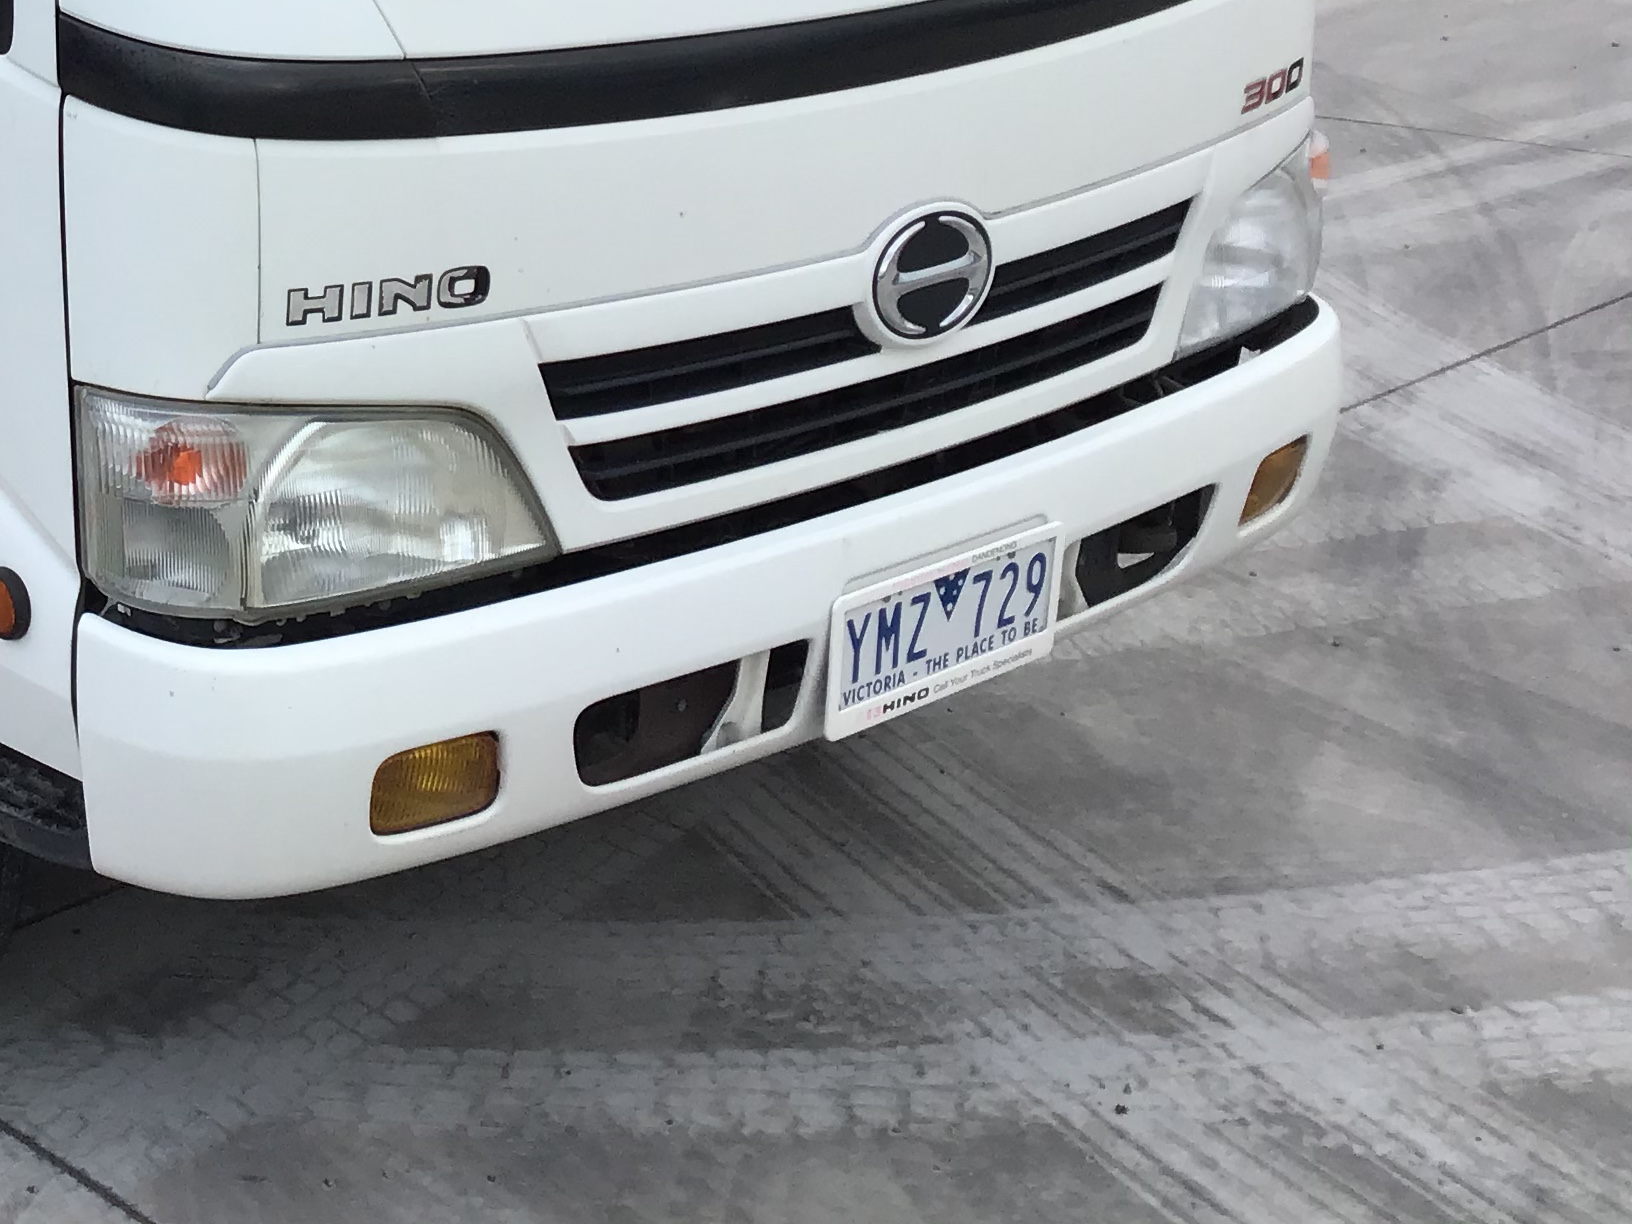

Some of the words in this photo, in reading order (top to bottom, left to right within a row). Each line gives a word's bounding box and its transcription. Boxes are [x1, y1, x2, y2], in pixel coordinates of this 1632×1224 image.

[1240, 57, 1304, 115] 300
[286, 265, 491, 326] HINO
[847, 591, 932, 684] YMZ
[973, 552, 1047, 638] 729
[842, 670, 906, 706] VICTORIA
[926, 652, 949, 674] THE
[956, 634, 994, 663] PLACE
[1001, 626, 1017, 645] TO
[1024, 617, 1038, 637] BE
[882, 687, 930, 715] HINO
